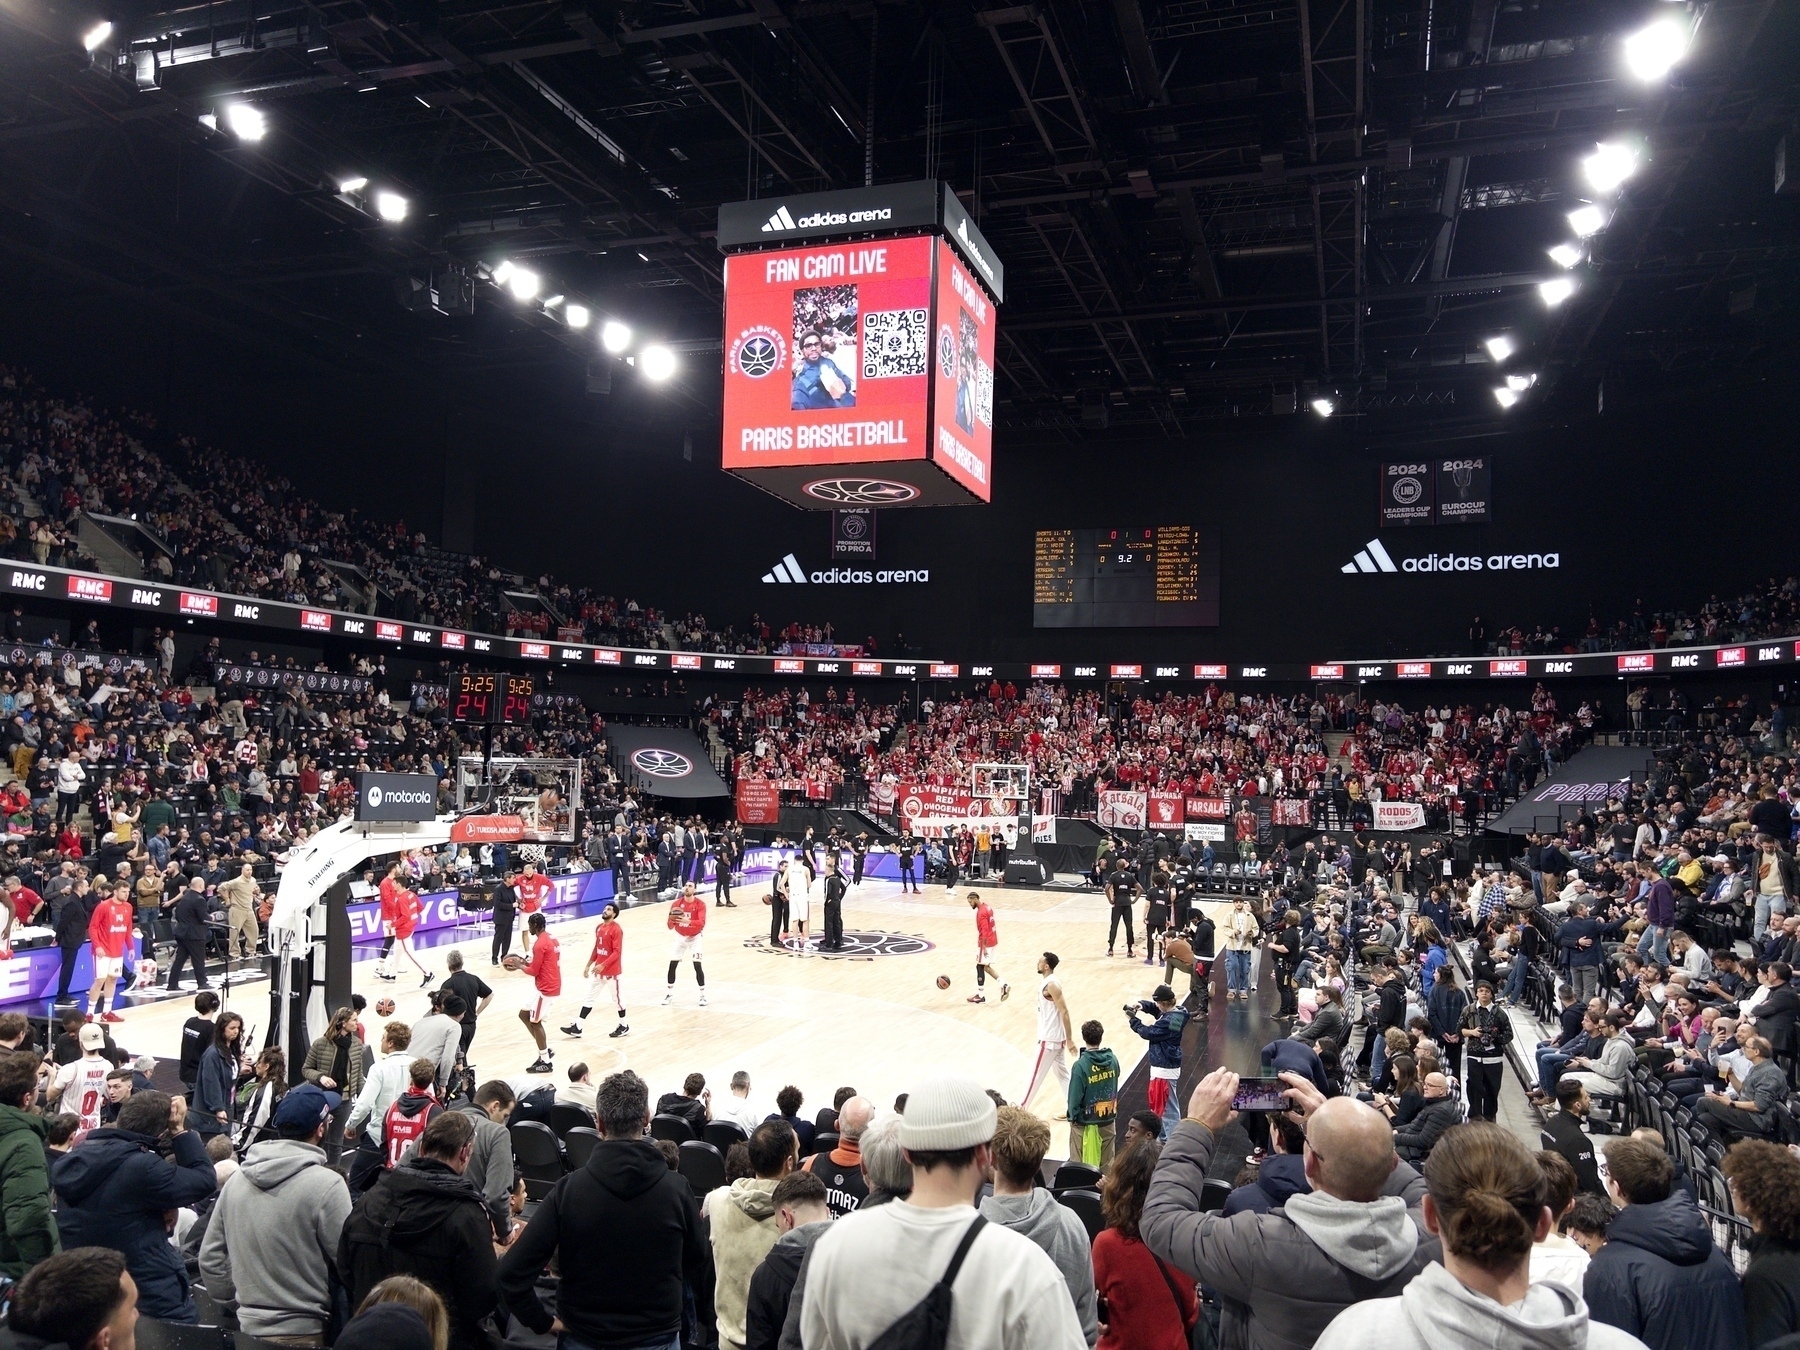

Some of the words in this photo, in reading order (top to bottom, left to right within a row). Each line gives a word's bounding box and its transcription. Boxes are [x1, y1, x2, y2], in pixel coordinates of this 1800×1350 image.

[798, 211, 847, 229] adidas
[849, 208, 891, 223] arena
[766, 258, 800, 283] FAN
[804, 253, 844, 279] CAM
[848, 249, 887, 276] LIVE
[952, 264, 963, 297] FAN
[964, 280, 975, 312] CAM
[976, 296, 986, 325] LIVE
[742, 427, 793, 451] PARIS
[796, 420, 907, 447] BASKETBALL
[940, 426, 956, 461] PARIS
[956, 441, 986, 484] BASKETBALL
[1388, 464, 1427, 476] 2024
[1443, 459, 1483, 471] 2024
[1401, 486, 1414, 495] LNB
[1442, 502, 1485, 510] EUROCUP
[1111, 531, 1116, 539] 0
[1402, 554, 1482, 572] adidas
[1487, 553, 1559, 570] arena
[12, 572, 46, 590] RMC
[811, 568, 873, 583] adidas
[876, 570, 928, 582] arena
[77, 580, 104, 595] RMC
[132, 590, 161, 606] RMC
[188, 596, 210, 609] RMC
[235, 604, 259, 619] RMC
[307, 613, 326, 625] RMC
[344, 620, 364, 633] RMC
[382, 625, 397, 635] RMC
[414, 631, 431, 642] RMC
[447, 635, 460, 644] RMC
[475, 640, 490, 651] RMC
[526, 644, 544, 654] RMC
[563, 649, 582, 659] RMC
[600, 652, 616, 660] RMC
[1723, 650, 1739, 661] RMC
[1759, 647, 1780, 660] RMC
[635, 655, 657, 665] RMC
[677, 656, 695, 665] RMC
[715, 660, 735, 669] RMC
[780, 661, 797, 670] RMC
[1625, 656, 1647, 667] RMC
[1672, 655, 1698, 667] RMC
[818, 664, 838, 672] RMC
[858, 664, 876, 672] RMC
[895, 666, 916, 674] RMC
[936, 666, 953, 674] RMC
[972, 667, 992, 675] RMC
[1037, 666, 1054, 674] RMC
[1075, 668, 1096, 676] RMC
[1117, 666, 1135, 674] RMC
[1156, 668, 1179, 676] RMC
[1201, 666, 1220, 674] RMC
[1243, 668, 1266, 676] RMC
[1318, 666, 1337, 675] RMC
[1359, 667, 1381, 676] RMC
[1404, 664, 1424, 673] RMC
[1448, 665, 1472, 674] RMC
[1498, 662, 1520, 671] RMC
[1546, 662, 1572, 672] RMC
[462, 677, 494, 692] 9:25
[509, 679, 532, 695] 9:25
[457, 695, 487, 717] 24
[505, 696, 526, 718] 24
[385, 790, 430, 804] motorola
[1533, 784, 1630, 801] PARIS
[936, 795, 953, 804] RED
[1100, 792, 1144, 812] Farsala
[1187, 801, 1224, 814] FARSALA
[1378, 807, 1411, 816] RODOS
[308, 857, 335, 888] SPALDING
[82, 1091, 98, 1116] 0
[826, 1188, 859, 1211] TMAZ
